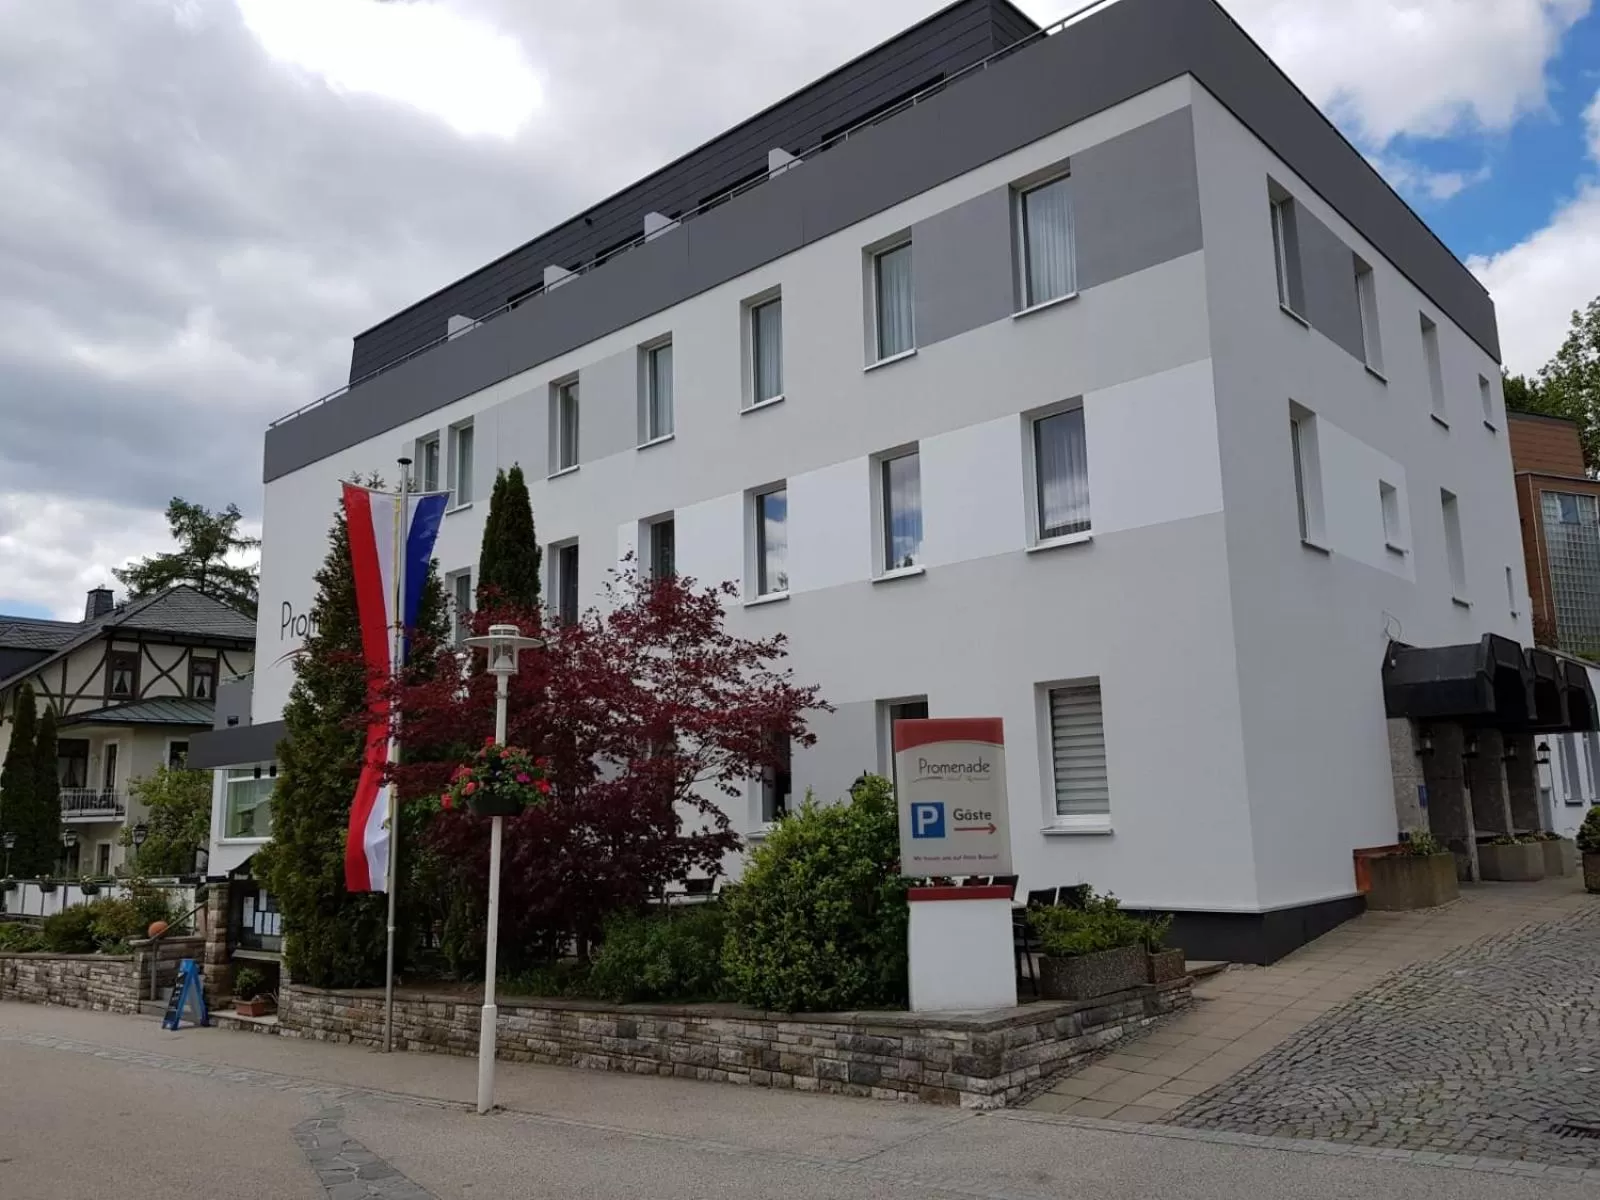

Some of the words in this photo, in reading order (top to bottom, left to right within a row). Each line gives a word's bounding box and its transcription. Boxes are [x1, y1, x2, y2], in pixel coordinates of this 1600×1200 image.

[918, 756, 990, 774] Promenade
[917, 806, 939, 835] P
[952, 808, 992, 821] Gäste
